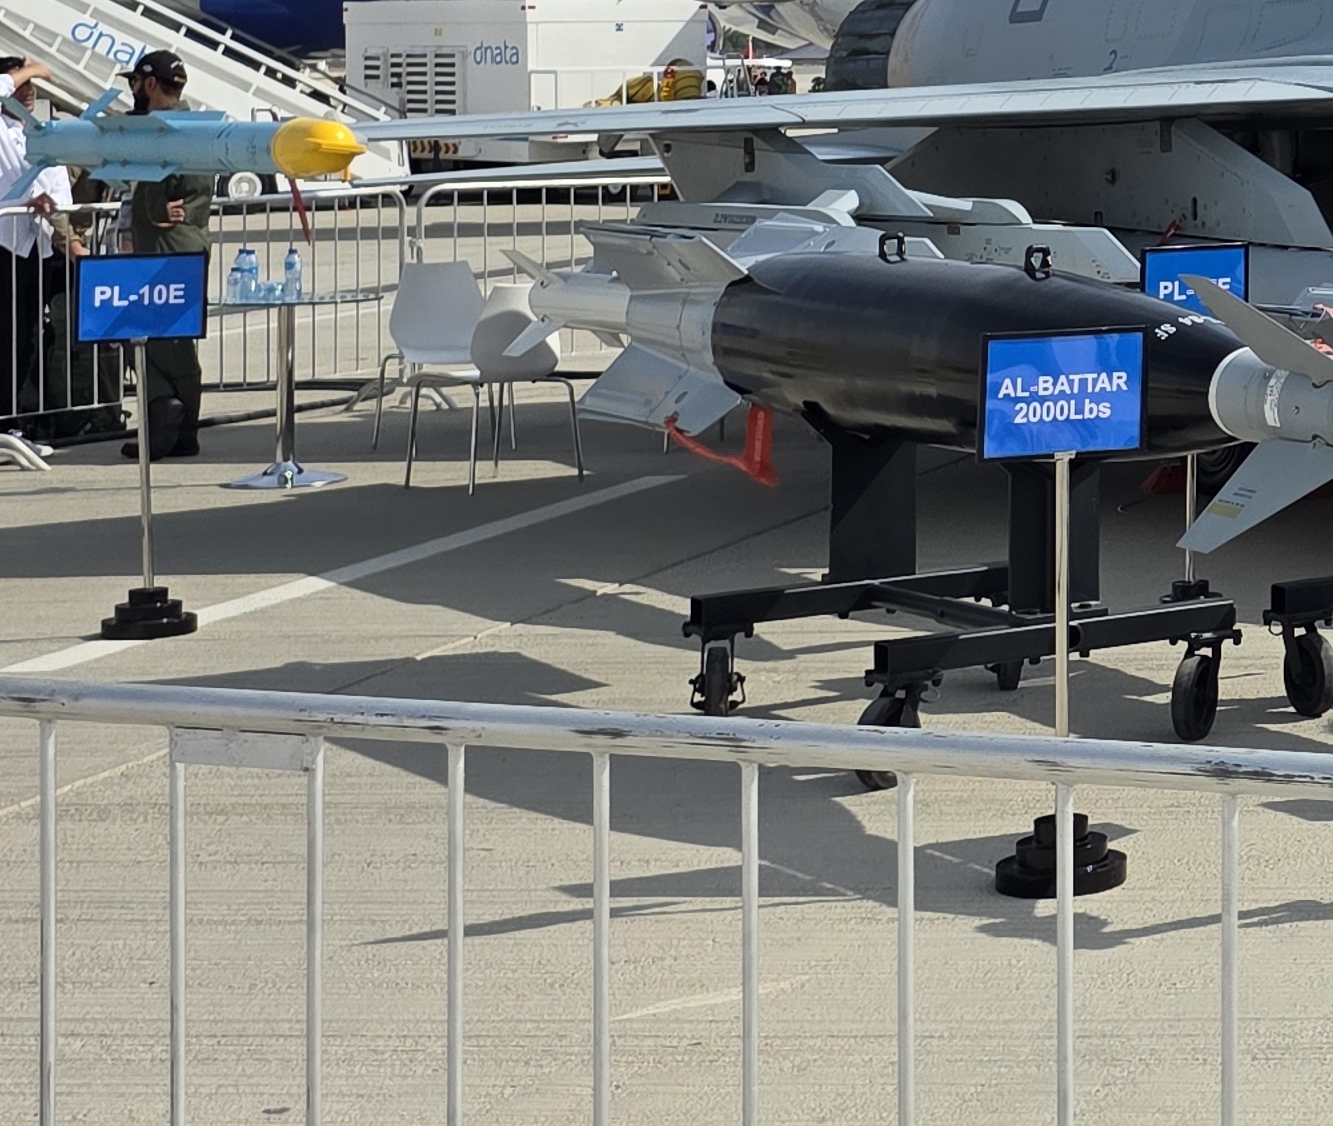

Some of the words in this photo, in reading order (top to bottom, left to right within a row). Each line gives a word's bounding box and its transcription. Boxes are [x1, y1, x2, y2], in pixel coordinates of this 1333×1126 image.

[71, 21, 150, 69] dna
[473, 40, 519, 66] dnata
[94, 283, 186, 307] PL-10E
[1159, 277, 1231, 301] PL-E
[998, 371, 1128, 399] AL-BATTAR
[1013, 398, 1112, 424] 2000Lbs
